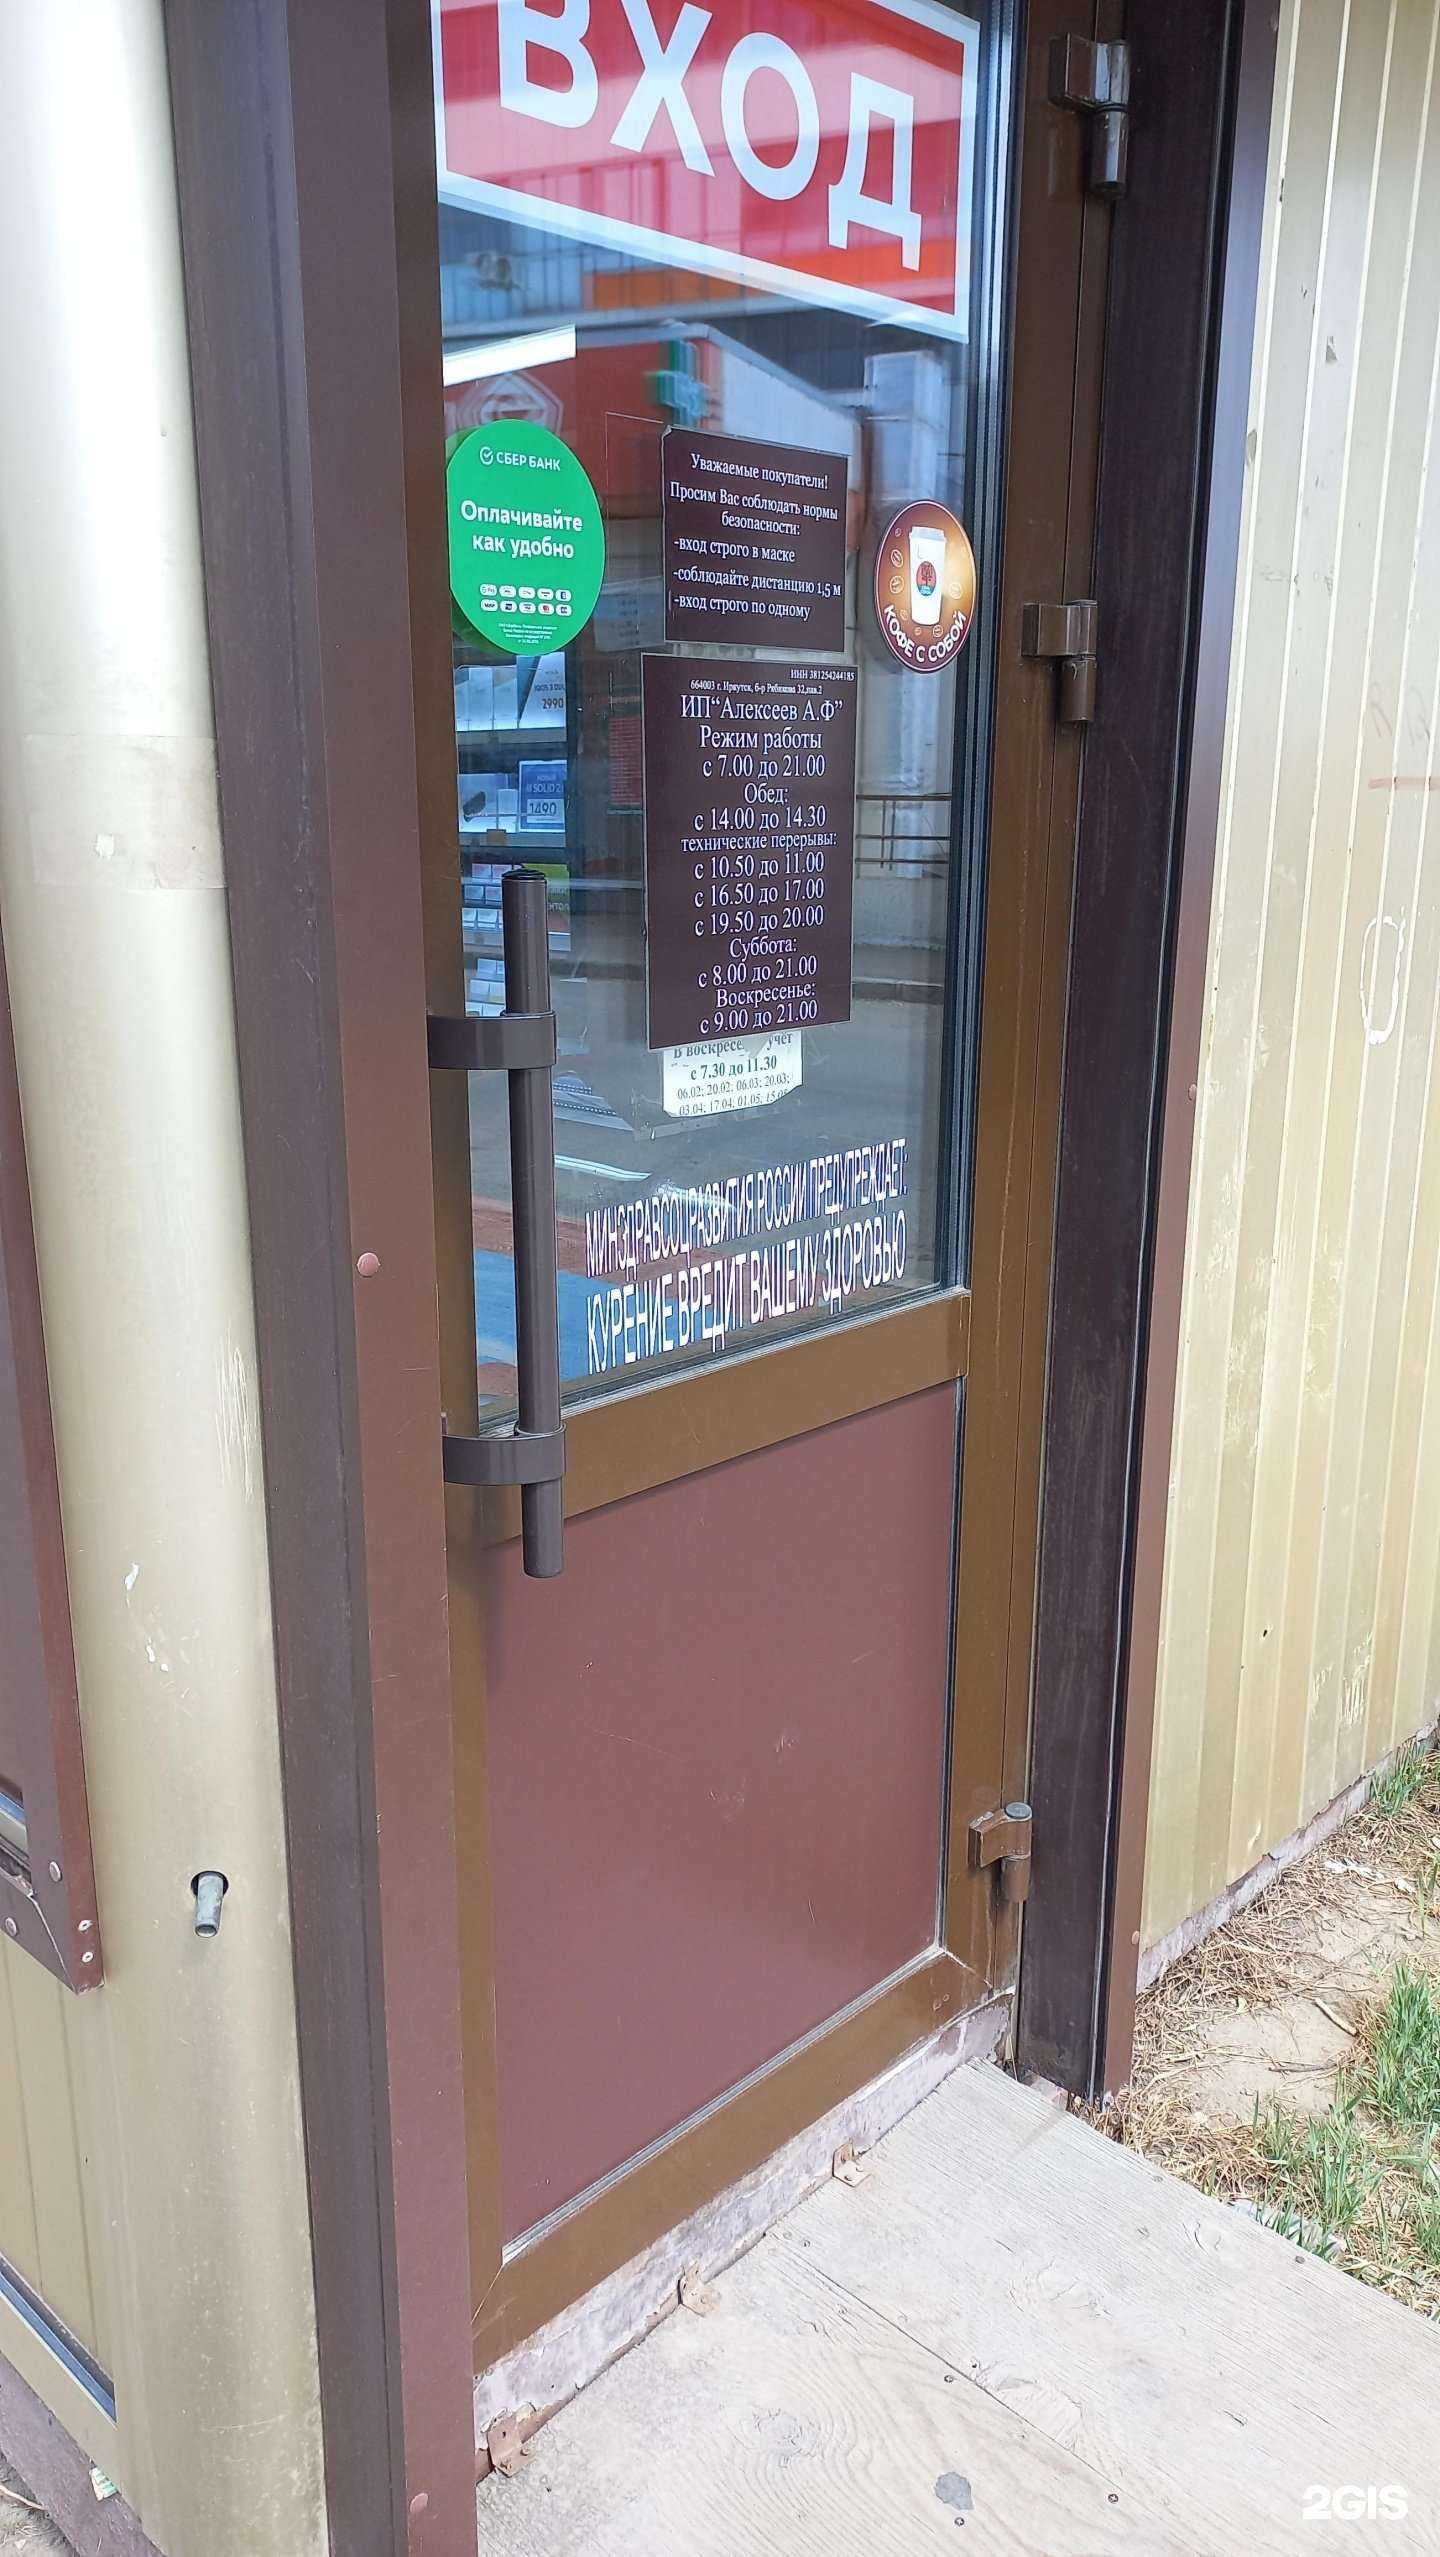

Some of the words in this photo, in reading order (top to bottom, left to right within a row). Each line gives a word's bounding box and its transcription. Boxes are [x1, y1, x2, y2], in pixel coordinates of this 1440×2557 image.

[499, 0, 922, 272] ВХОД
[496, 451, 527, 467] СБЕР
[528, 455, 561, 471] БАНК
[690, 453, 759, 478] Уважаемые
[761, 468, 828, 490] покупатели!
[670, 481, 716, 503] Просим
[719, 488, 740, 506] Вас
[742, 494, 800, 515] соблюдать
[802, 505, 838, 521] нормы
[461, 500, 583, 531] Оплачивайте
[721, 510, 801, 536] безопасности:
[472, 535, 506, 553] как
[510, 536, 575, 558] удобно
[674, 537, 708, 555] -вход
[709, 543, 749, 559] строго
[752, 546, 759, 556] в
[761, 547, 796, 562] маске
[673, 565, 750, 587] -соблюдайте
[751, 575, 815, 594] дистанцию
[816, 582, 830, 597] 1,5
[832, 586, 841, 596] м
[674, 595, 708, 611] -вход
[709, 599, 749, 614] строго
[751, 603, 766, 614] по
[768, 604, 811, 621] одному
[883, 604, 915, 659] КОФЕ
[915, 645, 926, 663] С
[927, 609, 967, 663] СОБОЙ
[790, 669, 808, 679] ИНН
[699, 725, 759, 748] Режим
[763, 726, 822, 754] работы
[703, 760, 712, 777] с
[717, 754, 753, 777] 7.00
[758, 760, 778, 780] до
[782, 754, 825, 777] 21.00
[744, 782, 789, 806] Обед:
[529, 802, 557, 816] 1490
[694, 814, 704, 831] с
[711, 807, 755, 830] 14.00
[759, 812, 779, 832] до
[786, 805, 826, 828] 14.30
[681, 835, 767, 852] технические
[770, 832, 837, 852] перерывы:
[694, 864, 704, 880] с
[711, 854, 754, 879] 10.50
[758, 860, 779, 878] до
[785, 851, 825, 874] 11.00
[694, 892, 704, 908] с
[711, 882, 754, 907] 16.50
[758, 887, 778, 905] до
[784, 878, 824, 901] 17.00
[694, 920, 704, 936] с
[711, 910, 754, 935] 19.50
[758, 914, 778, 933] до
[782, 905, 824, 929] 20.00
[729, 936, 797, 962] Суббота:
[698, 972, 708, 988] с
[712, 962, 747, 987] 8.00
[751, 966, 771, 984] до
[776, 955, 818, 979] 21.00
[716, 982, 816, 1008] Воскресенье:
[700, 1019, 709, 1034] с
[714, 1008, 748, 1032] 9.00
[752, 1011, 772, 1029] до
[776, 1000, 818, 1024] 21.00
[690, 1069, 697, 1080] с
[700, 1062, 726, 1080] 7.30
[728, 1065, 744, 1077] до
[747, 1055, 777, 1073] 11.30
[585, 1172, 755, 1282] МИНЗДРАВСОЦРАЗВИТИЯ
[757, 1160, 808, 1231] РОССИИ
[809, 1138, 908, 1227] ПРЕДУПРЕЖДАЕТ:
[587, 1273, 674, 1375] КУРЕНИЕ
[677, 1253, 747, 1353] ВРЕДИТ
[750, 1233, 820, 1325] ВАШЕМУ
[821, 1208, 907, 1315] ЗДОРОВЬЮ
